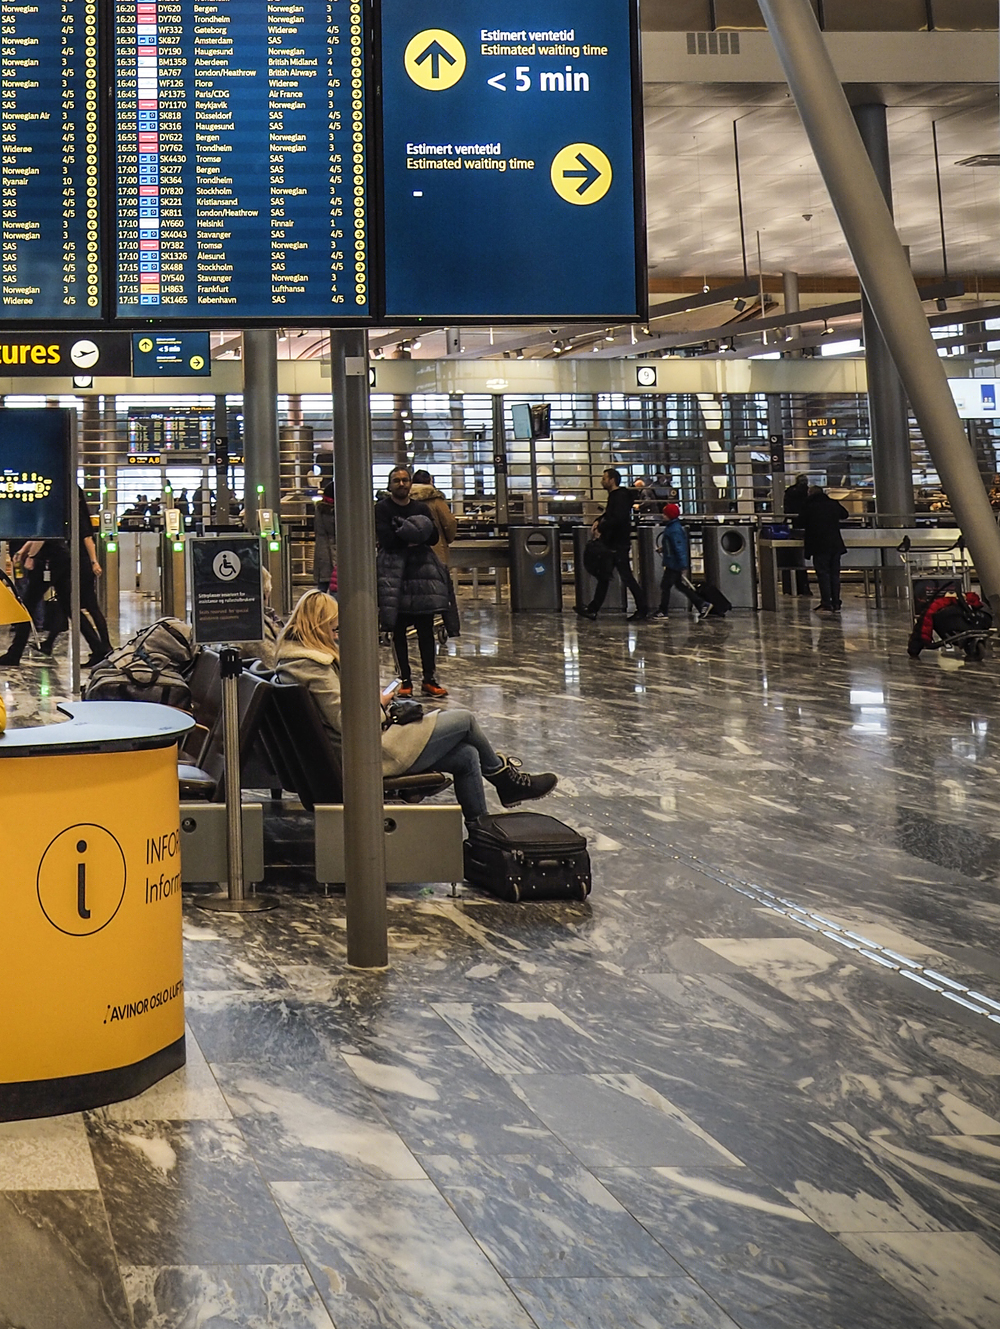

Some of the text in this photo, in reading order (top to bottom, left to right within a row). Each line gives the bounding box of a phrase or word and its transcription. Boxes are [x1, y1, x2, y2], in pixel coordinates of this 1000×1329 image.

[1, 36, 39, 46] Norwegian
[61, 36, 67, 45] 3
[480, 28, 575, 42] Estimert ventetid
[481, 43, 609, 58] Estimated waiting time
[487, 65, 590, 92] < 5 min
[117, 111, 137, 120] 16:55
[195, 111, 232, 120] Düsseldorf
[269, 111, 283, 120] SAS
[328, 110, 341, 120] 4/5
[406, 142, 501, 155] Estimert ventetid
[406, 157, 535, 172] Estimated waiting time
[2, 177, 28, 187] Ryanair
[63, 177, 72, 186] 10
[118, 285, 139, 294] 17:15
[197, 284, 229, 293] Frankfurt
[271, 284, 305, 293] Lufthansa
[331, 284, 337, 292] 4
[3, 296, 33, 305] Widerøe
[63, 296, 76, 305] 4/5
[110, 997, 149, 1022] AVINOR
[149, 988, 169, 1010] OSLO
